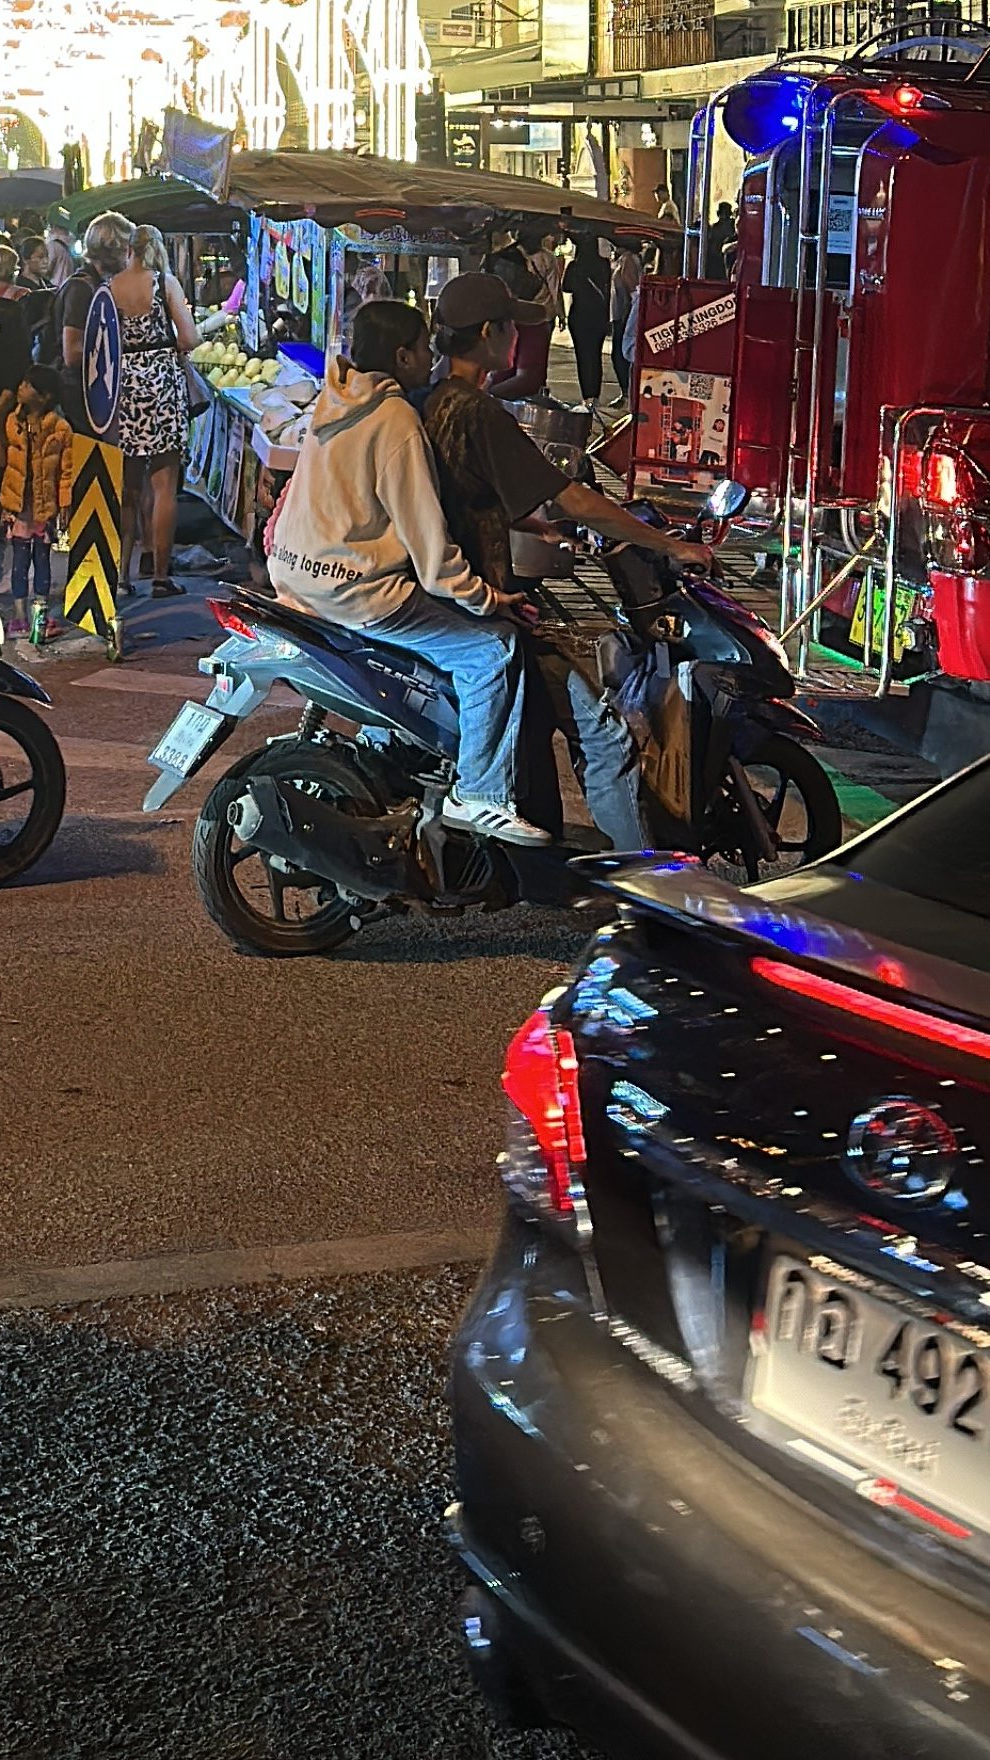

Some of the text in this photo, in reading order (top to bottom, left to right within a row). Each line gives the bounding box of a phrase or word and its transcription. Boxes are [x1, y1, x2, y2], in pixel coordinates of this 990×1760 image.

[687, 298, 737, 327] KINGDO
[300, 553, 363, 582] together
[877, 1319, 986, 1437] 492
